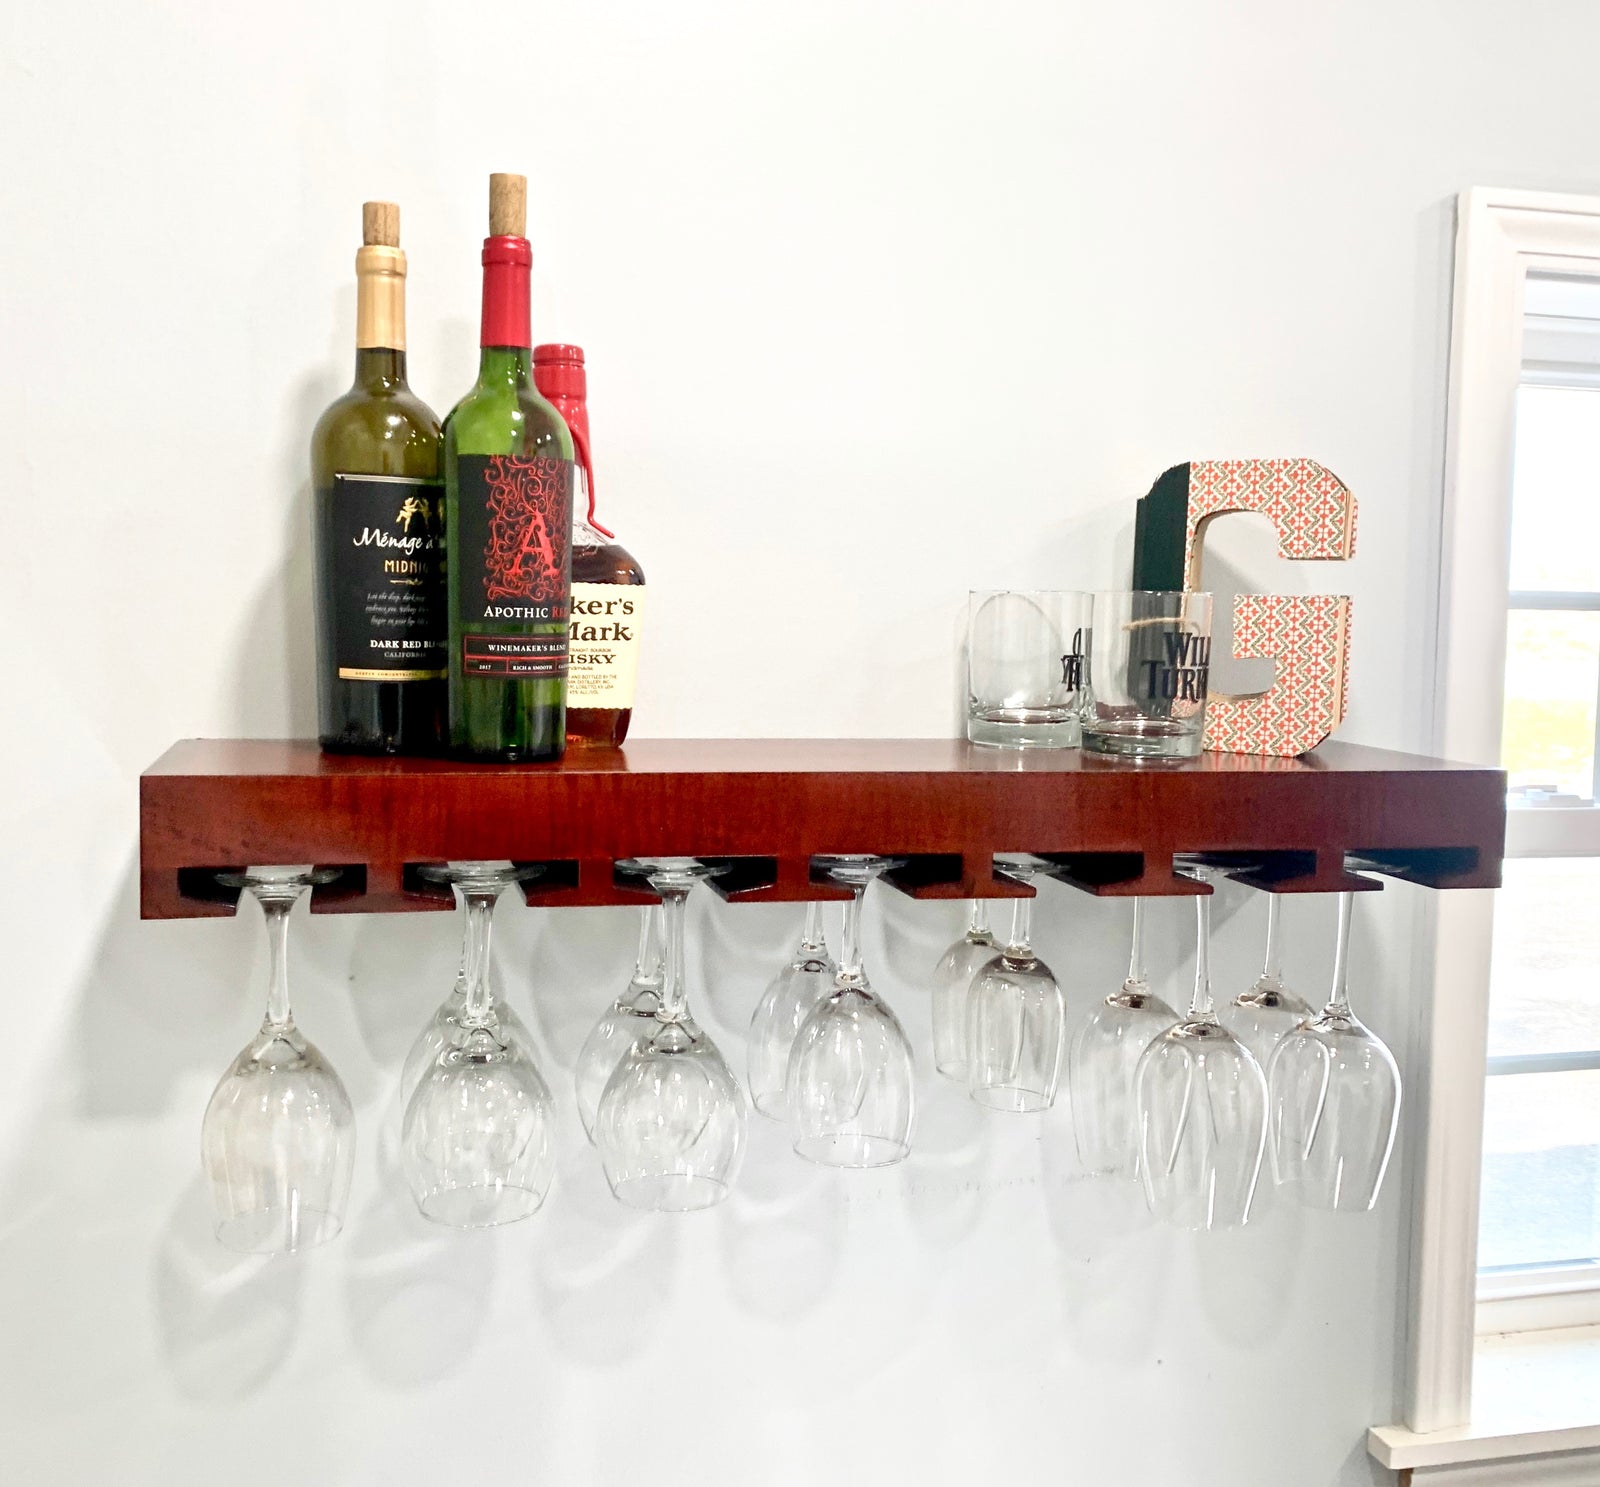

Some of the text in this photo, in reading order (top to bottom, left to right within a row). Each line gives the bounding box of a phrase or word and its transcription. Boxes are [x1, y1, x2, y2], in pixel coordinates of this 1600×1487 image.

[353, 526, 423, 556] Ménage
[483, 605, 549, 619] APOTHIC
[370, 639, 400, 649] DARK
[402, 640, 422, 650] RED
[488, 644, 548, 653] WINEMAKER'S
